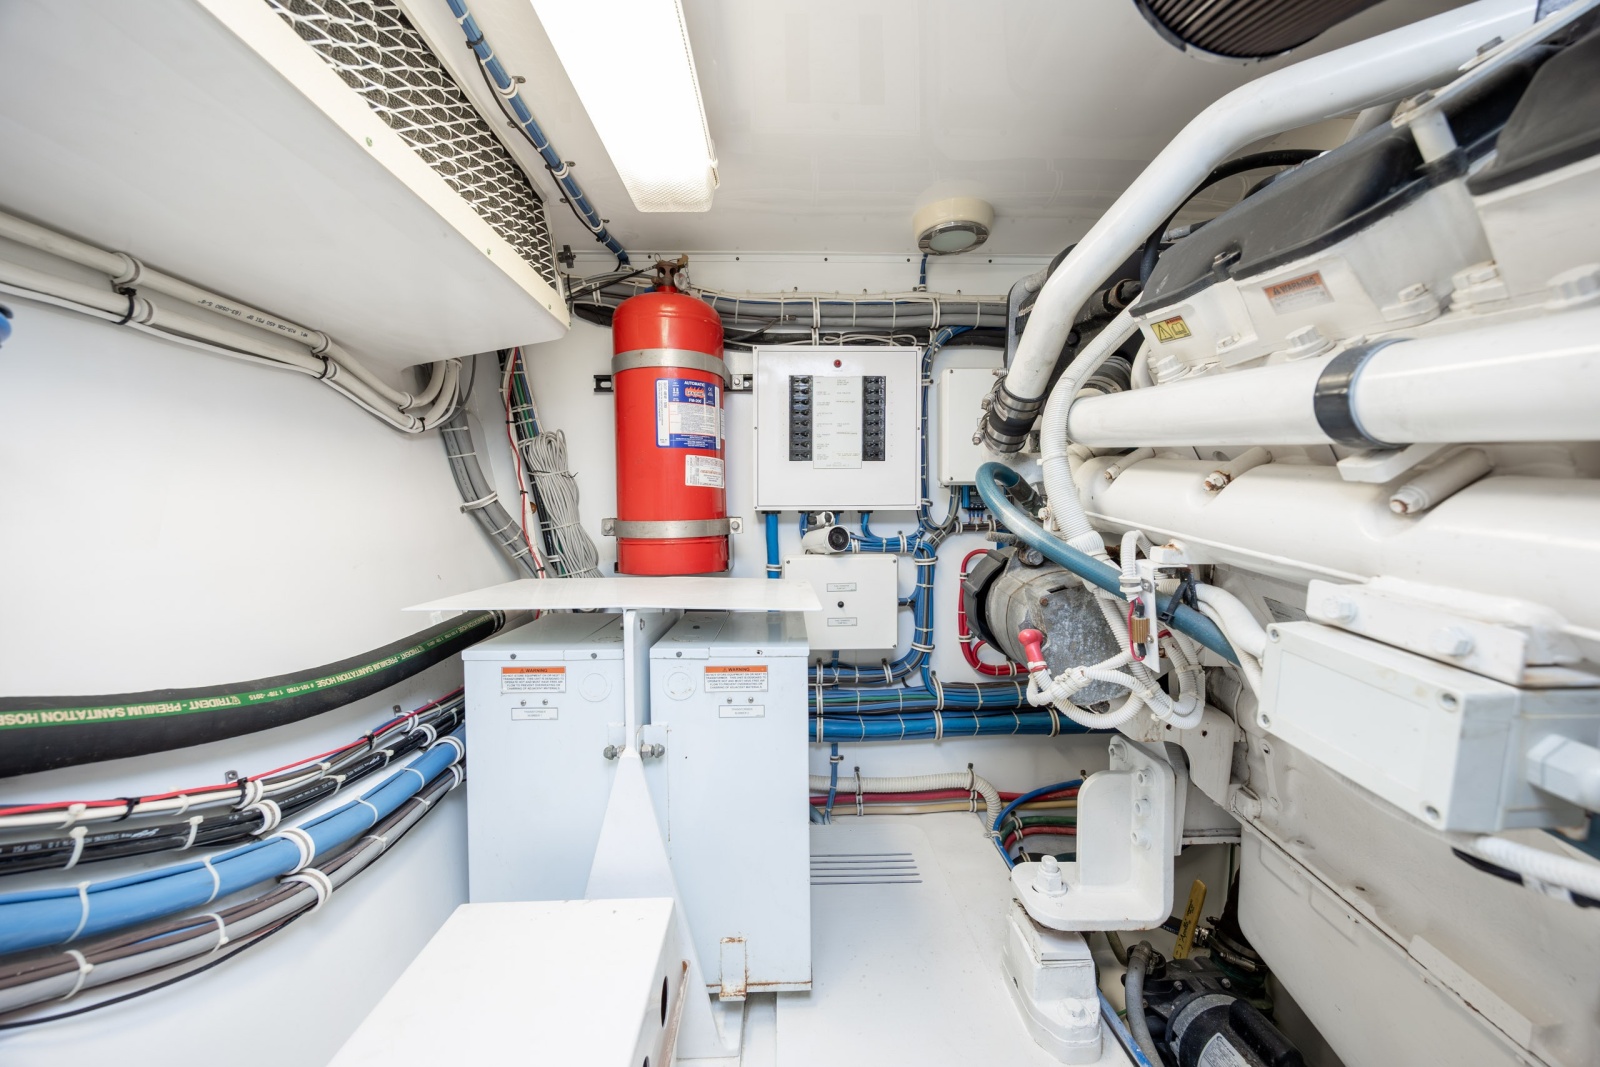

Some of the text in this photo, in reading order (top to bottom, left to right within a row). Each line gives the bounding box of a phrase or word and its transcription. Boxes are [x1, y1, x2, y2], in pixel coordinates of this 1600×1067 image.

[1280, 277, 1317, 294] WARNING
[373, 656, 398, 671] PREMIUM
[338, 666, 373, 682] SANITATION
[316, 676, 336, 688] HOSE
[126, 702, 182, 716] PREMIUM
[189, 696, 232, 710] TRIDENT
[41, 707, 126, 723] SANITATION
